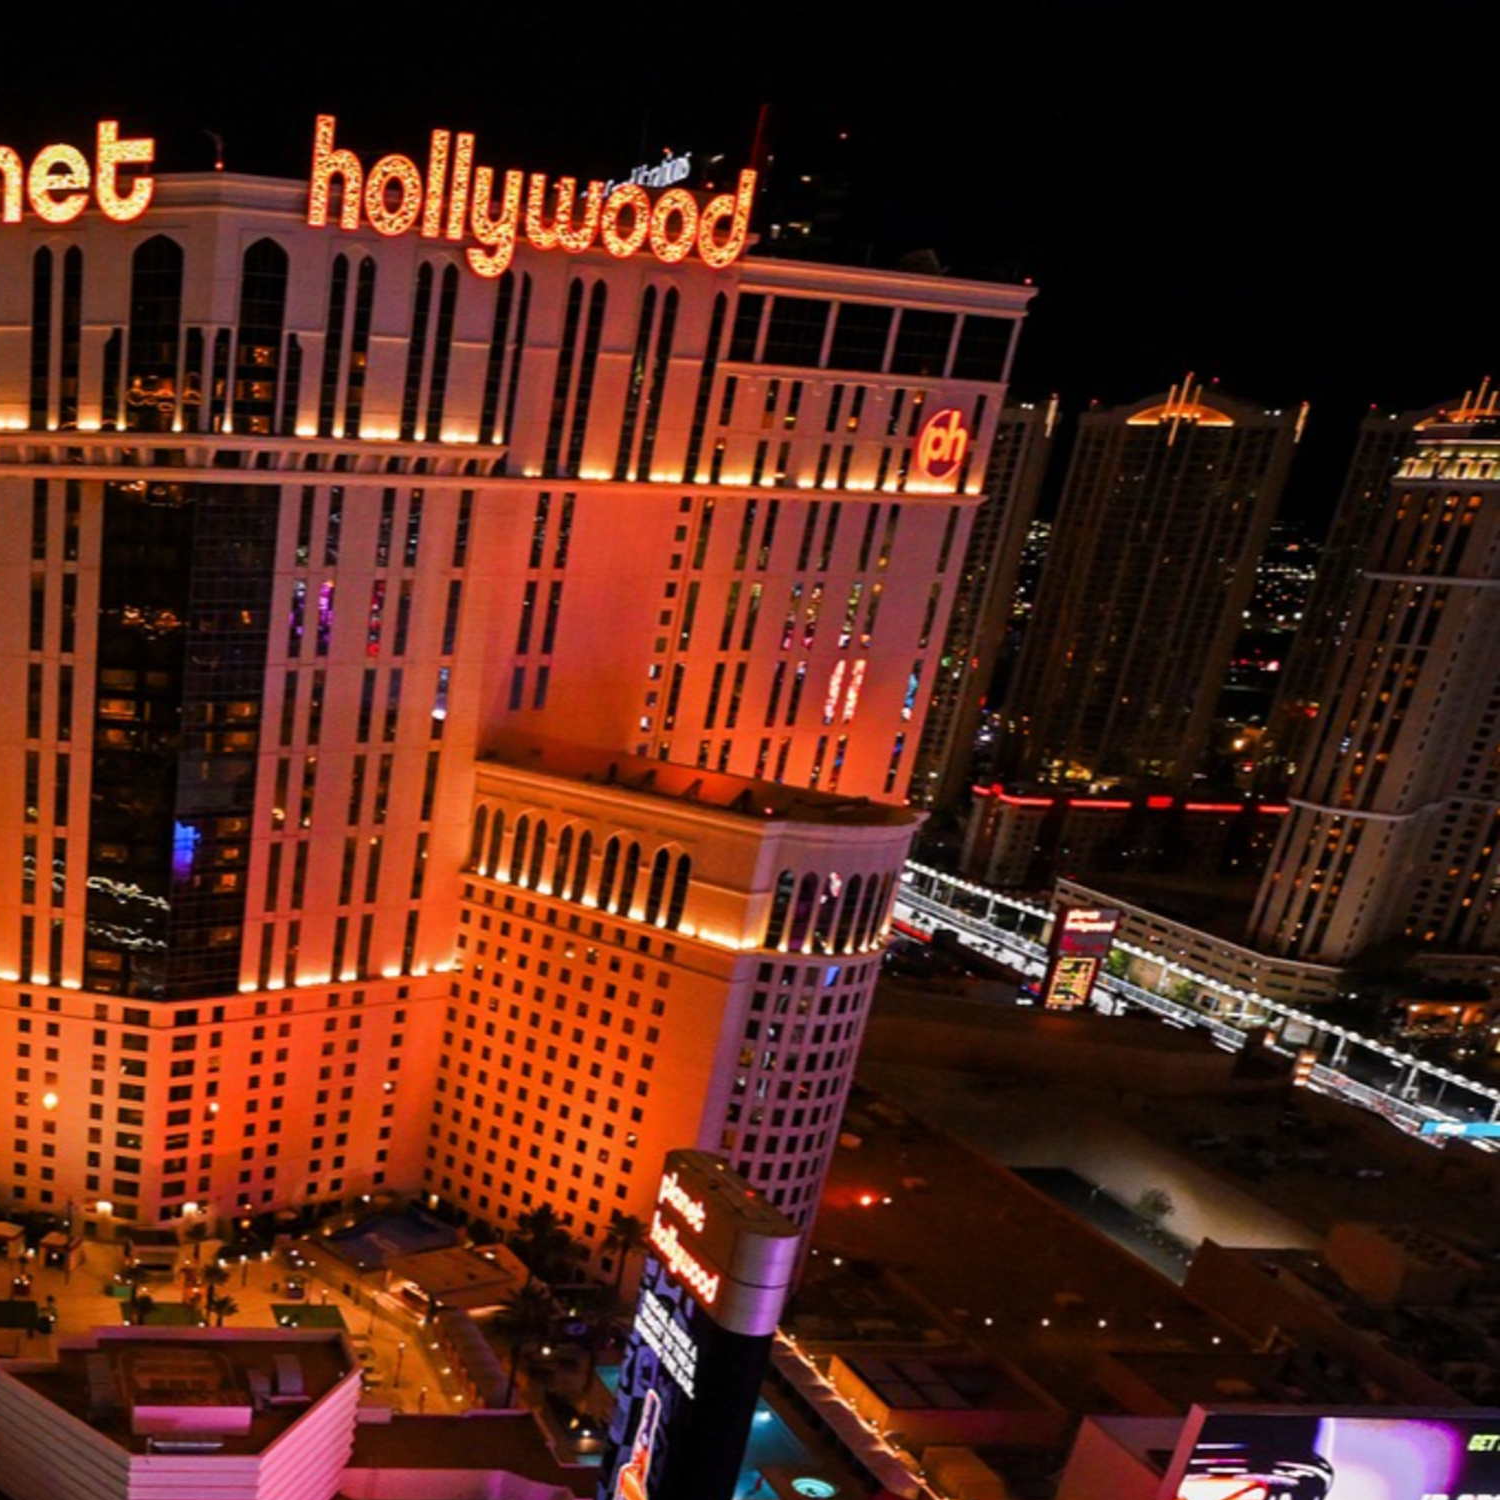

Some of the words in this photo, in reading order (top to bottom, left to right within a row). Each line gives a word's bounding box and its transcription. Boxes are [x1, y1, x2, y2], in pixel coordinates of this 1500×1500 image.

[307, 114, 757, 279] hollywood
[657, 1172, 706, 1233] planet
[650, 1210, 720, 1304] hollywood
